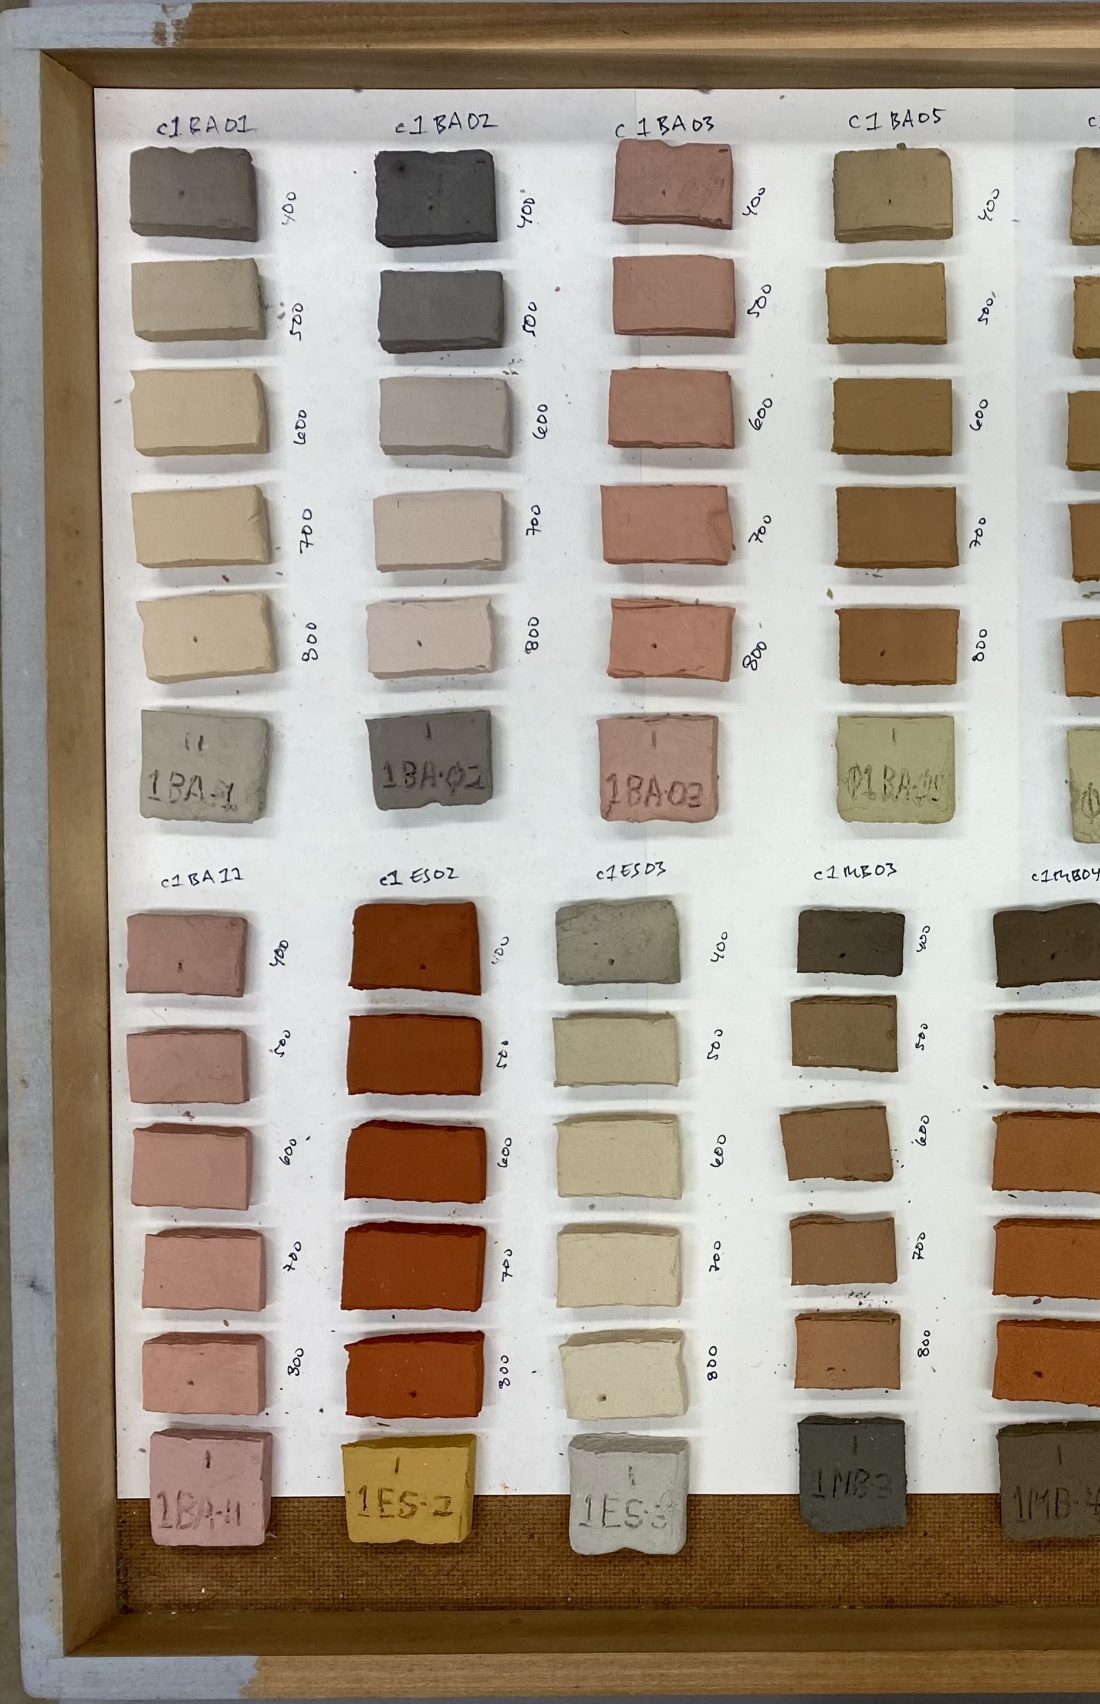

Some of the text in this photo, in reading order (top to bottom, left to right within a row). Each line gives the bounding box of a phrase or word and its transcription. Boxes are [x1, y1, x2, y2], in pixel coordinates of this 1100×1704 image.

[282, 192, 296, 226] 400
[517, 198, 535, 228] 400
[742, 187, 765, 216] 400
[978, 188, 1000, 221] 400
[747, 284, 771, 318] 500
[978, 298, 994, 325] 500
[289, 303, 303, 341] 500
[522, 302, 537, 336] 500
[294, 410, 307, 445] 600
[532, 404, 547, 439] 600
[750, 398, 772, 430] 600
[970, 399, 988, 431] 600
[300, 509, 312, 554] 700
[526, 505, 540, 536] 700
[748, 515, 771, 543] 700
[969, 517, 986, 548] 700
[302, 623, 318, 661] 800
[525, 617, 539, 654] 800
[972, 629, 987, 662] 800
[742, 642, 767, 671] 800
[270, 940, 289, 967] 400
[710, 932, 728, 962] 400
[916, 925, 930, 953] 400
[274, 1030, 291, 1058] 500
[707, 1029, 723, 1060] 500
[915, 1023, 928, 1050] 500
[496, 1040, 509, 1069] 500
[915, 1115, 929, 1146] 600
[280, 1138, 296, 1166] 600
[497, 1137, 512, 1168] 600
[710, 1135, 726, 1167] 600
[283, 1241, 301, 1272] 700
[709, 1241, 721, 1271] 700
[912, 1232, 926, 1260] 700
[502, 1249, 512, 1282] 700
[917, 1330, 930, 1357] 800
[499, 1355, 508, 1389] 800
[707, 1346, 717, 1380] 800
